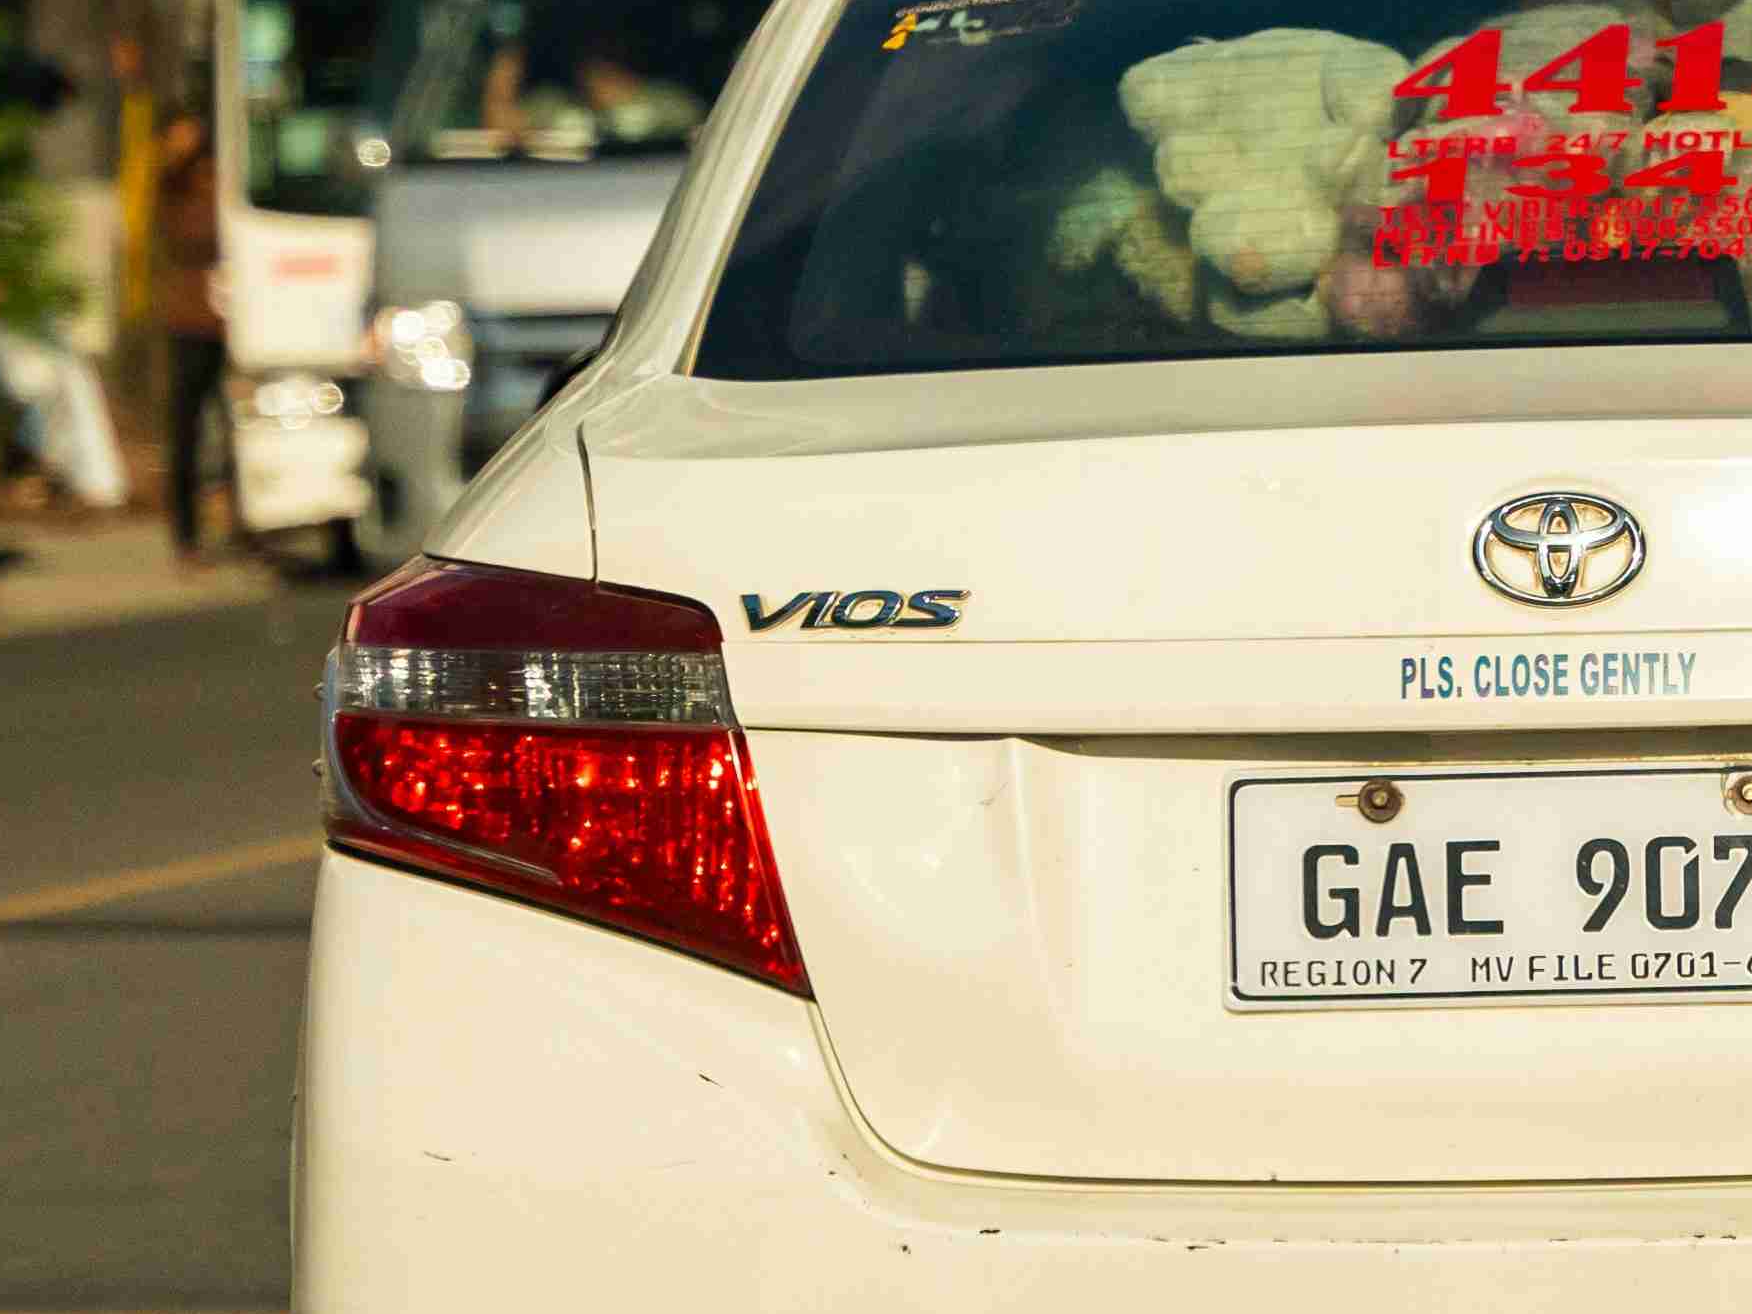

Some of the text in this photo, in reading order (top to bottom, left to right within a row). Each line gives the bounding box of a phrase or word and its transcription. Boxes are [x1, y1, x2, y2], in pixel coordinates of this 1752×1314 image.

[1387, 134, 1518, 159] LTFRB
[1544, 132, 1628, 155] 24/7
[740, 590, 972, 632] VIOS
[1400, 651, 1697, 700] PLS. CLOSE GENTLY
[1301, 840, 1504, 940] GAE
[1260, 959, 1396, 987] REGION
[1410, 958, 1428, 984] 7
[1471, 956, 1515, 982] MV
[1528, 953, 1617, 982] FILE
